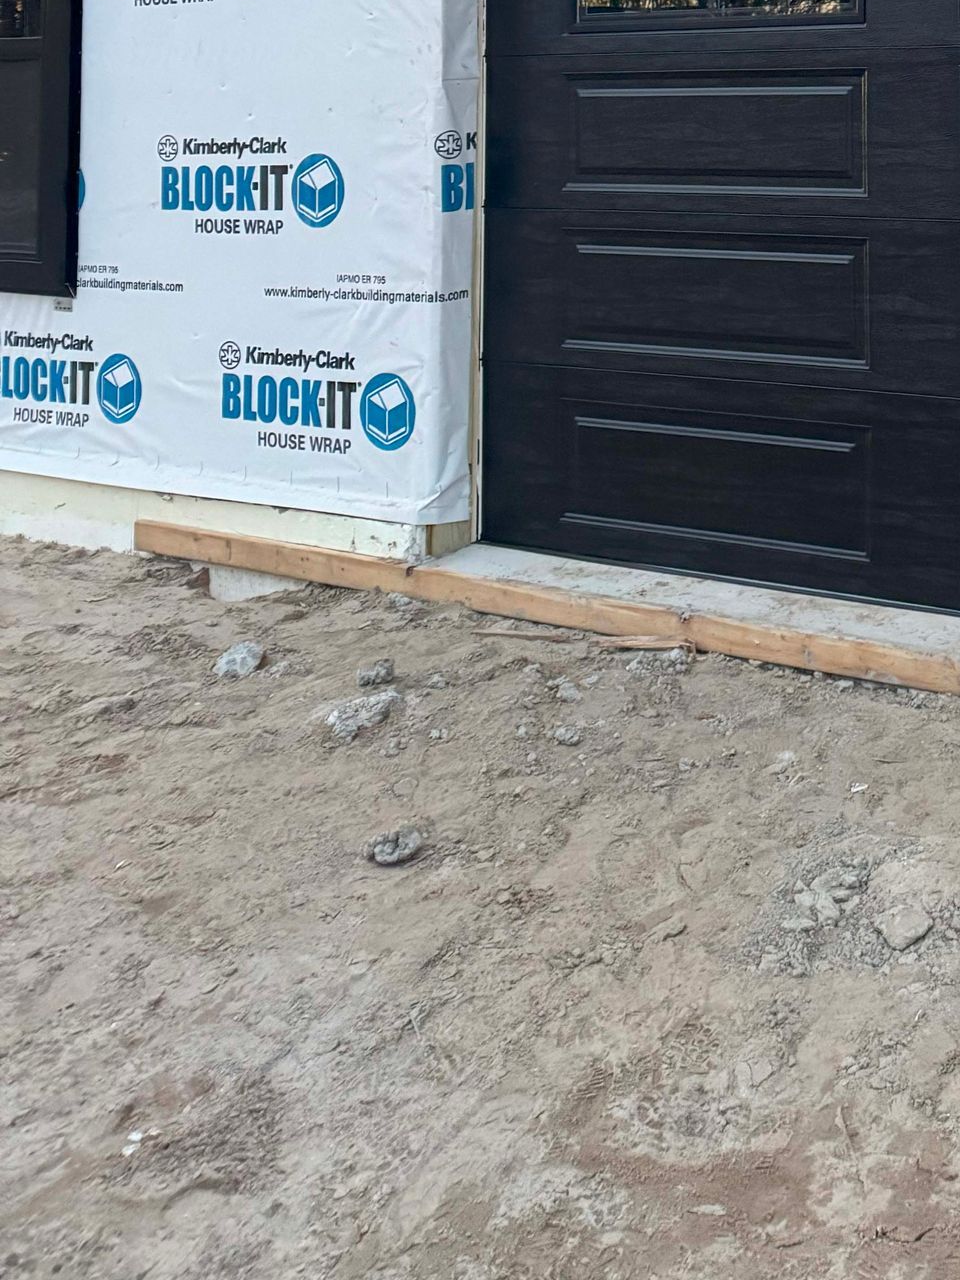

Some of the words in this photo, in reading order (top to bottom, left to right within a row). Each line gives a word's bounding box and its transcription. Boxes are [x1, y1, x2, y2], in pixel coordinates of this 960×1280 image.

[182, 136, 287, 159] Kimberly-Clark
[195, 218, 240, 234] HOUSE
[243, 219, 283, 235] WRAP
[4, 330, 93, 354] Kimberly-Clark
[246, 346, 355, 372] Kimberly-Clark
[13, 407, 53, 424] HOUSE
[55, 411, 89, 427] WRAP
[257, 431, 306, 451] HOUSE
[310, 435, 351, 455] WRAP
